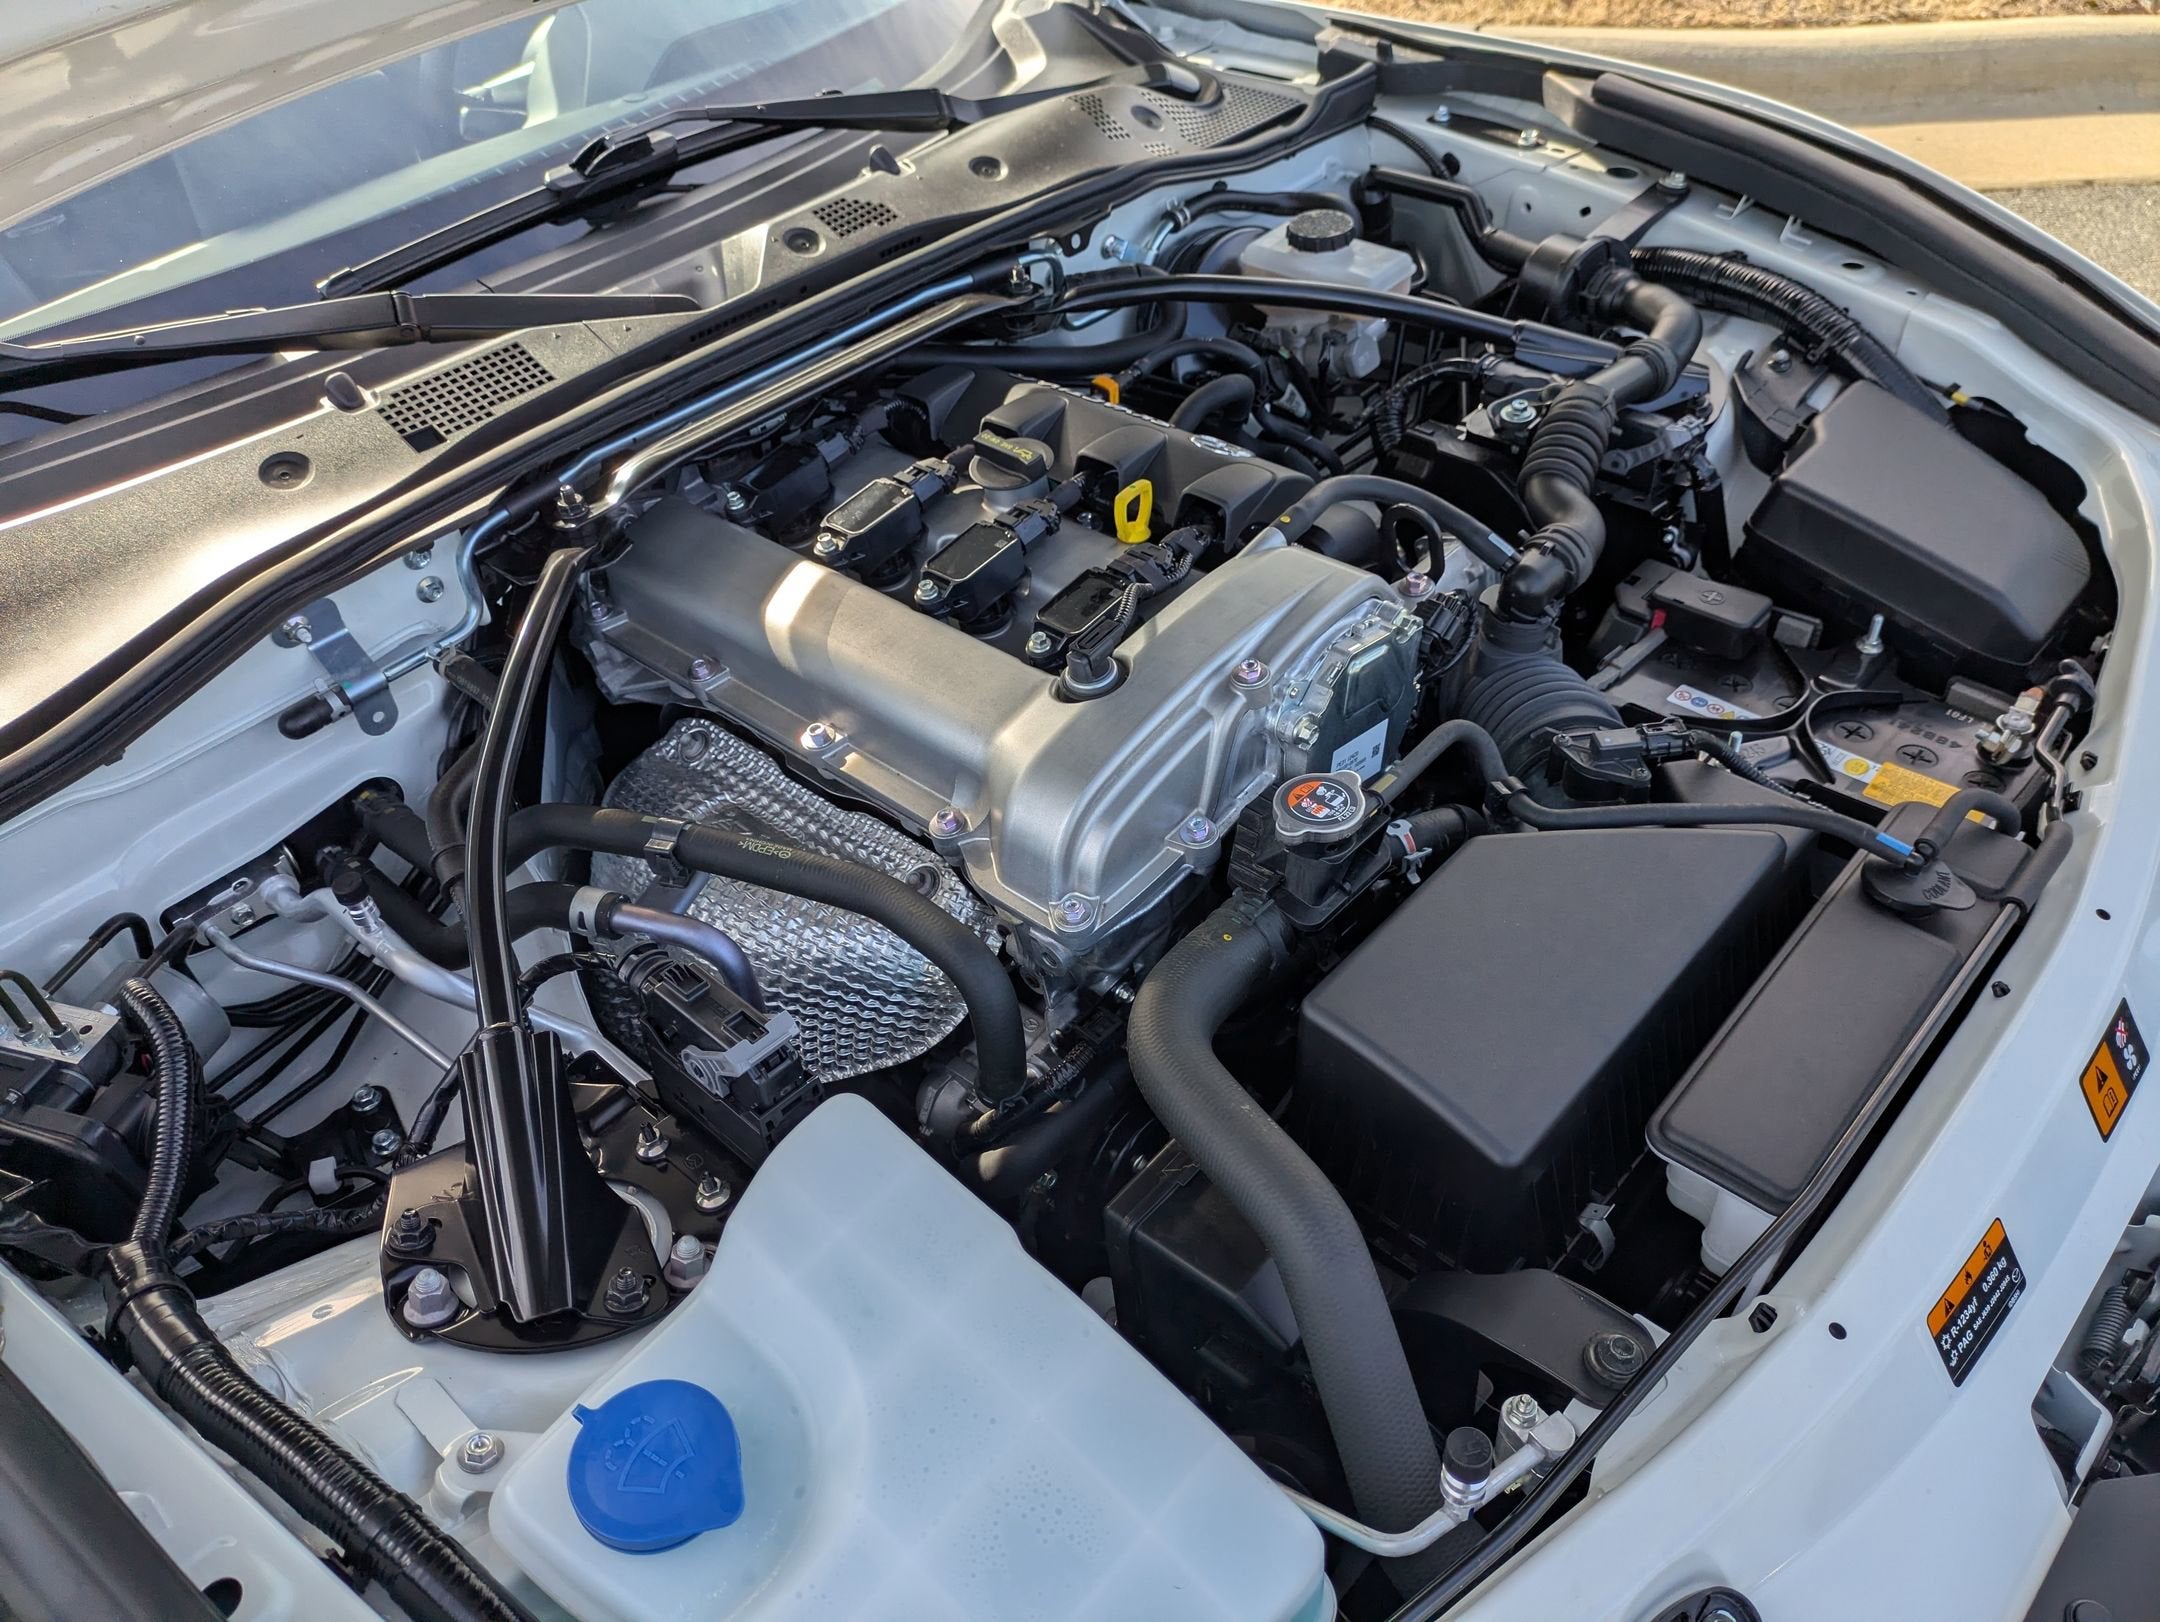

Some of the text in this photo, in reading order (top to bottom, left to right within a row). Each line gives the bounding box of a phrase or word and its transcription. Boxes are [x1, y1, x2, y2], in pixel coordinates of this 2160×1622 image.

[1950, 1257, 2007, 1338] R-1234yf 0.360 kg
[1957, 1330, 1974, 1353] PAG
